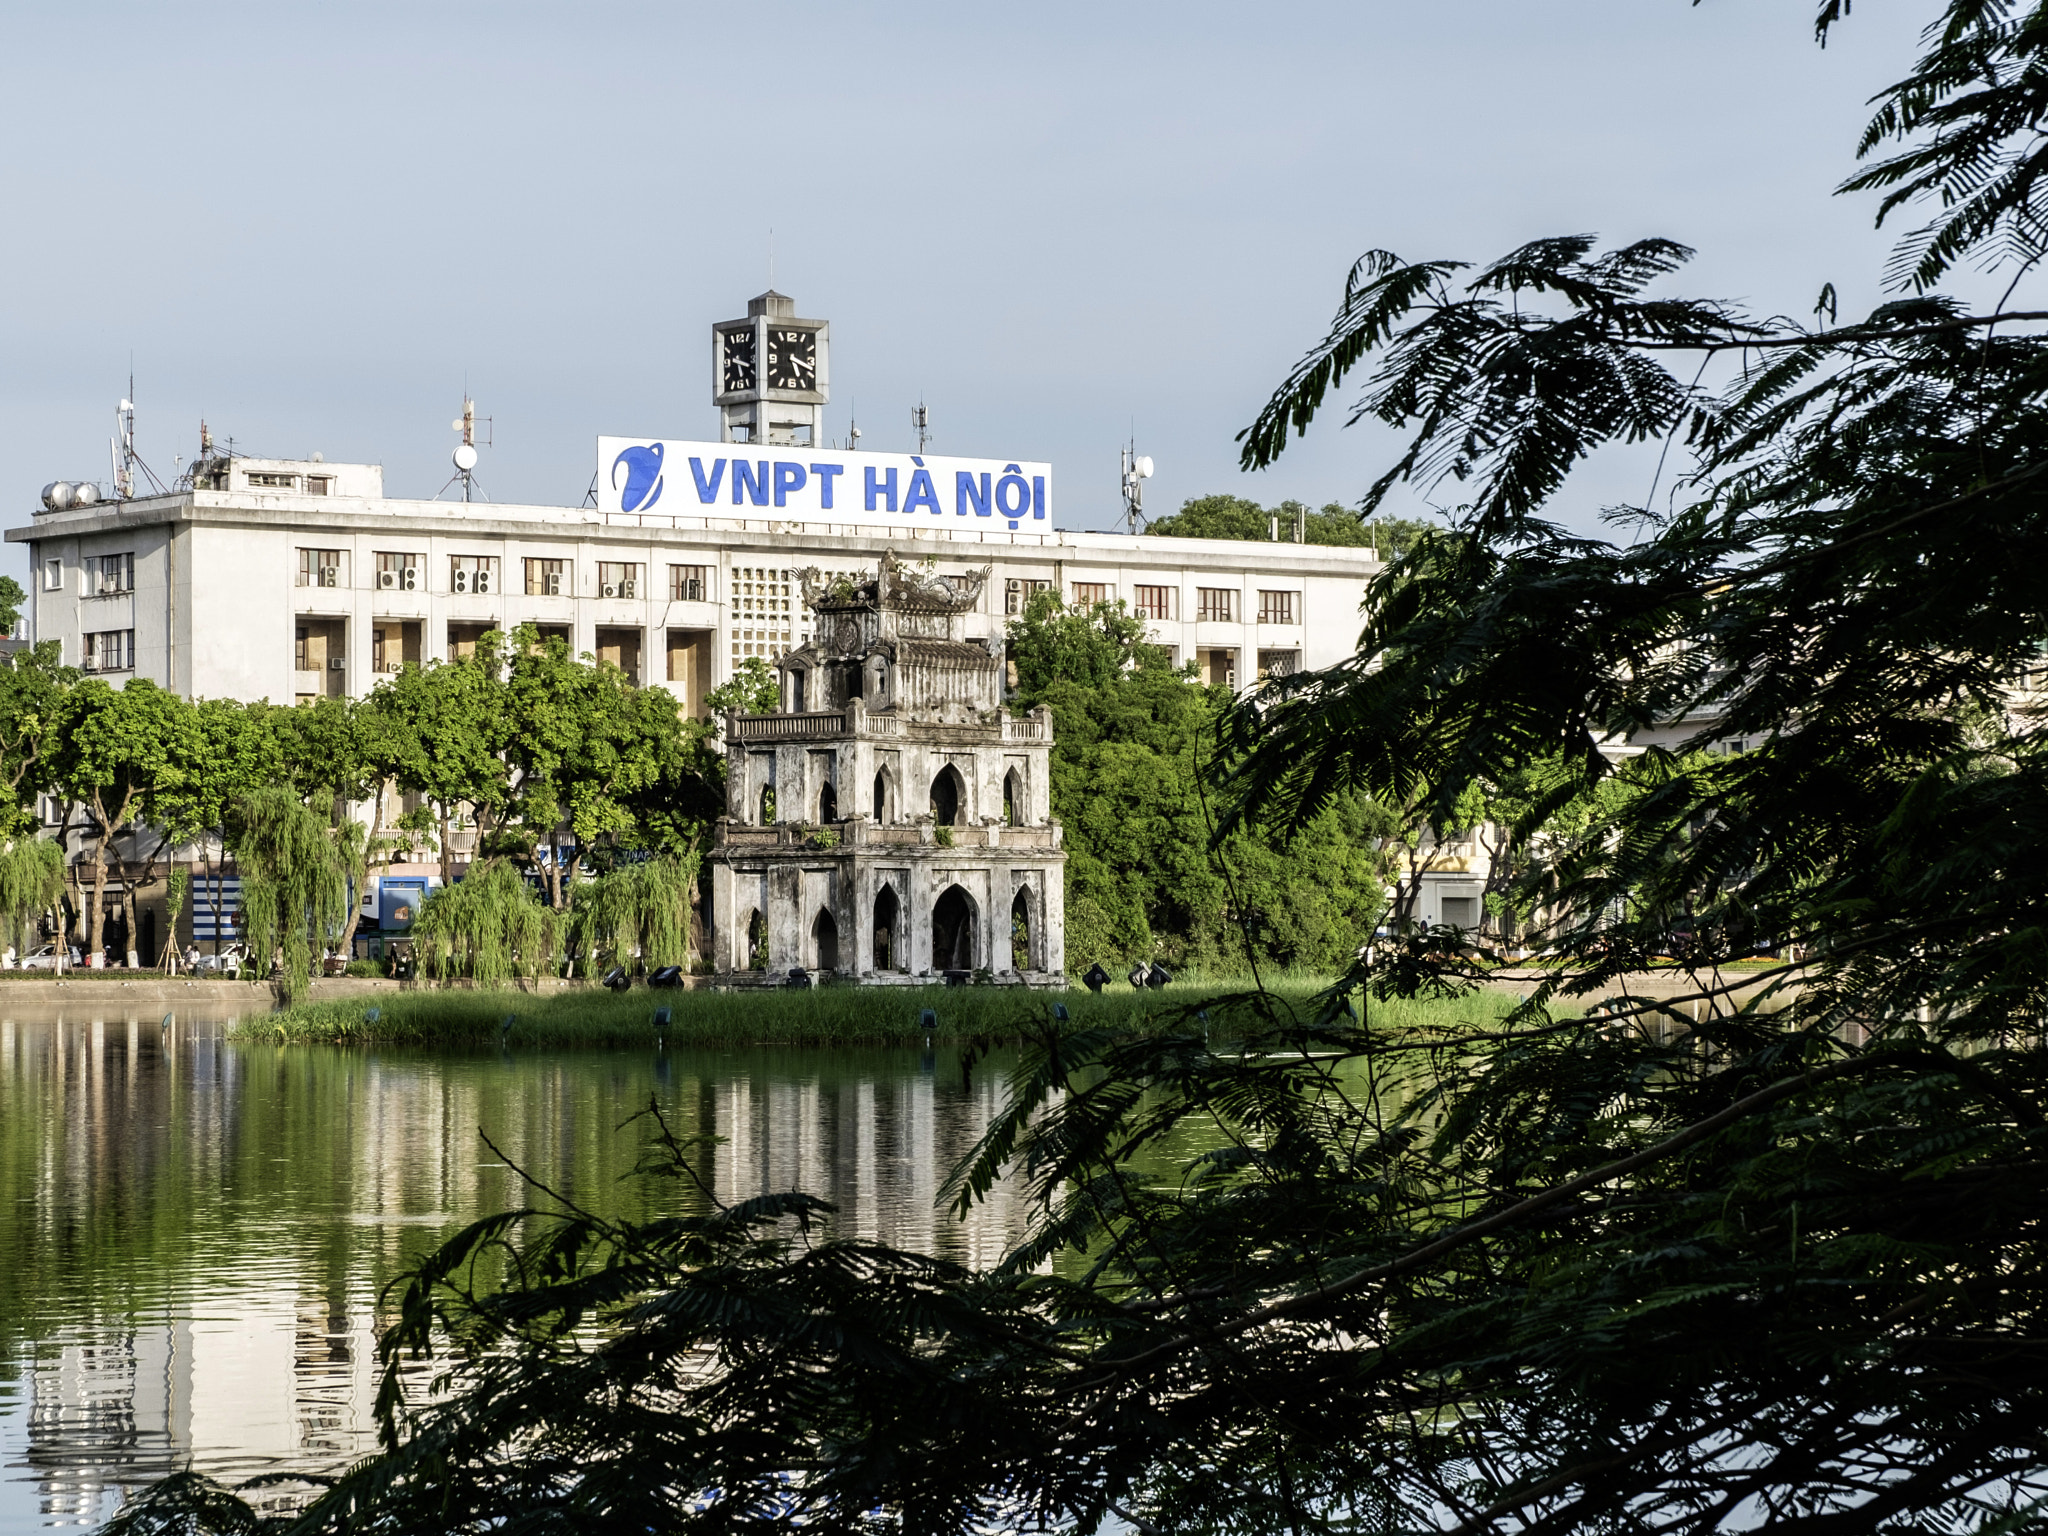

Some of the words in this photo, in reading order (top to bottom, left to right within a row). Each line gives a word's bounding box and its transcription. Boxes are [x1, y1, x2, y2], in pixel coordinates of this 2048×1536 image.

[786, 332, 798, 343] 12
[723, 358, 731, 368] 9
[768, 353, 778, 364] 9
[806, 356, 815, 367] 3
[736, 379, 744, 389] 6
[787, 378, 797, 388] 6
[687, 456, 844, 510] VNPT
[864, 455, 942, 516] HÀ
[955, 463, 1046, 530] NỘI
